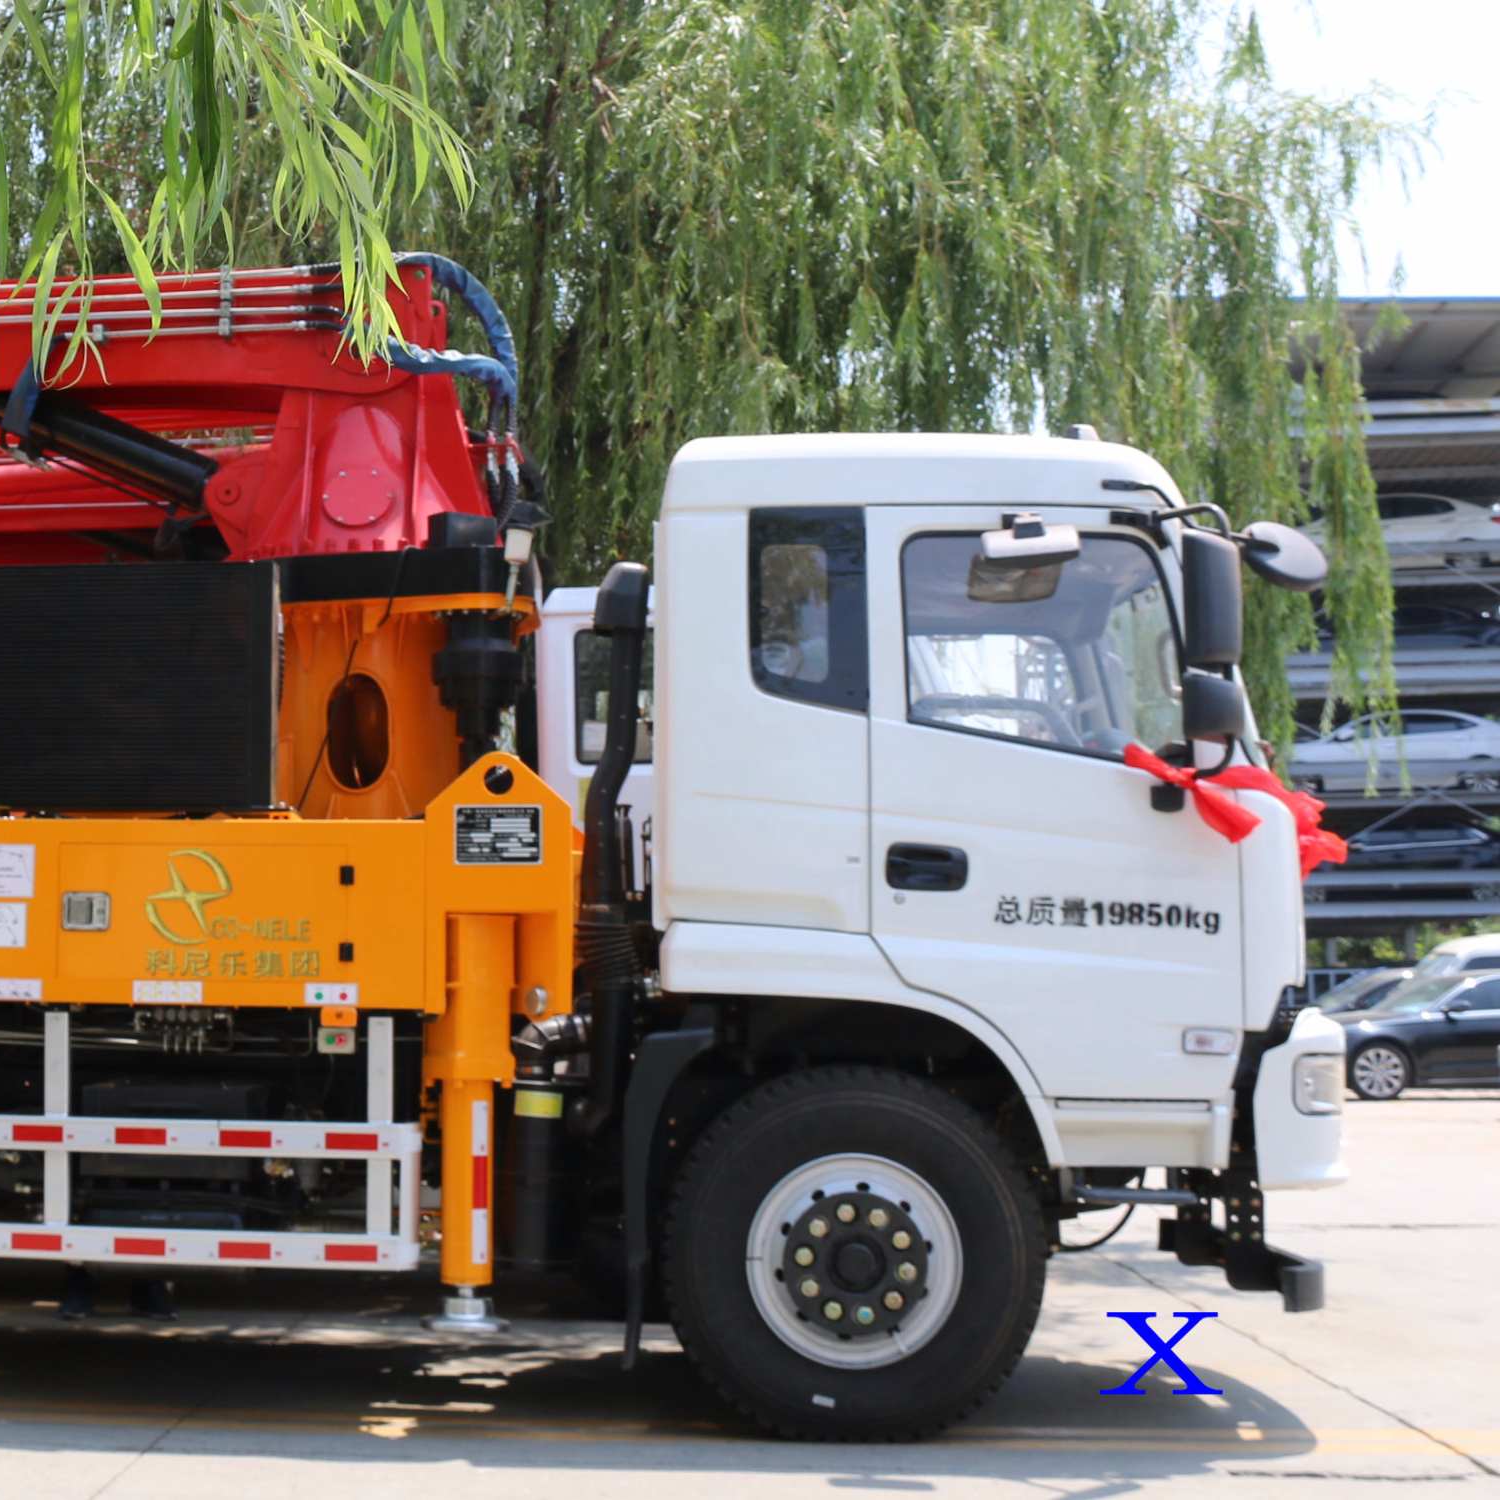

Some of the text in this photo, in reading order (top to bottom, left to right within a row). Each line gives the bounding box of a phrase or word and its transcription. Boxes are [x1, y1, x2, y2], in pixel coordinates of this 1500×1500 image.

[210, 916, 312, 941] CO-NELE
[994, 895, 1220, 934] 总质量19850kg
[145, 948, 320, 978] 科尼乐集团
